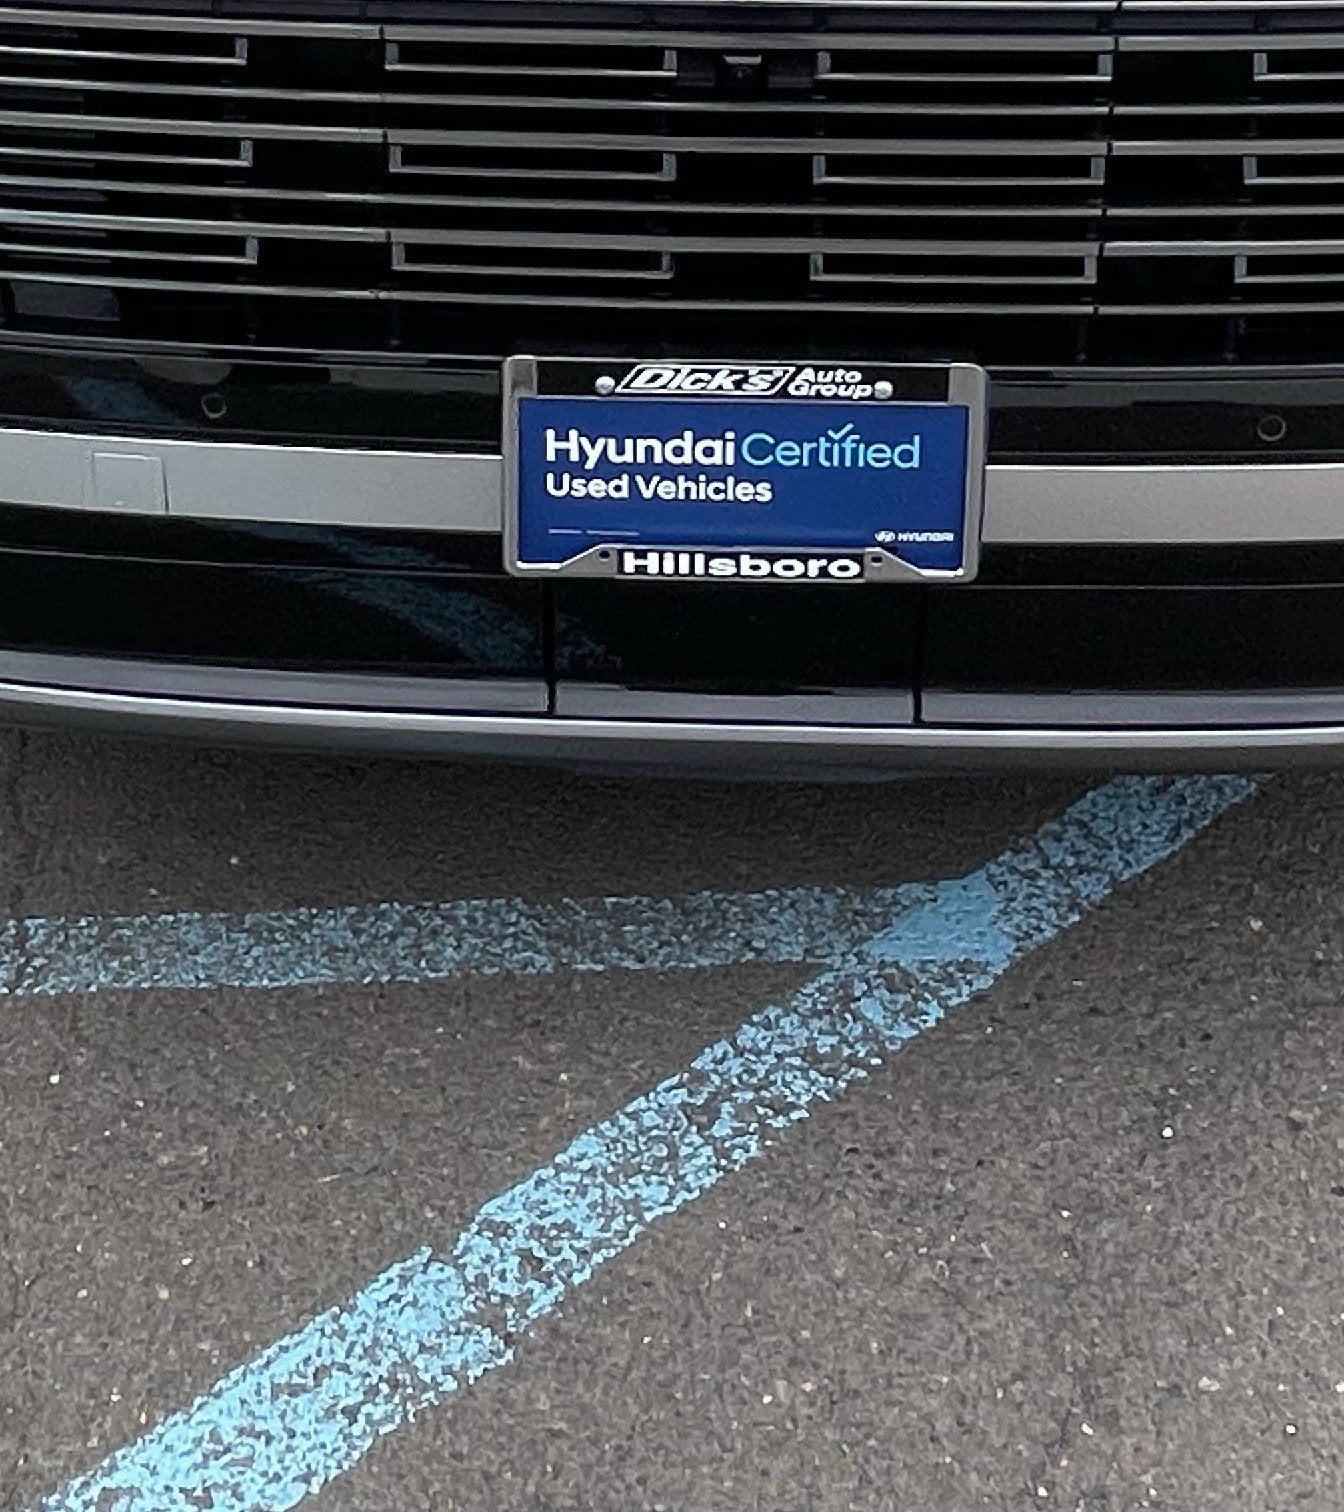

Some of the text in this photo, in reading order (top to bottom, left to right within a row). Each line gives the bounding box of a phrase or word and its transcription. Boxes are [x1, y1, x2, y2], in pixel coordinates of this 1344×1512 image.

[797, 366, 863, 385] Auto
[787, 381, 873, 400] Group
[545, 425, 921, 472] Hyundai Certified
[545, 473, 774, 503] Used Vehicles
[897, 532, 955, 543] HYUNDAI
[622, 550, 862, 580] Hillsboro
